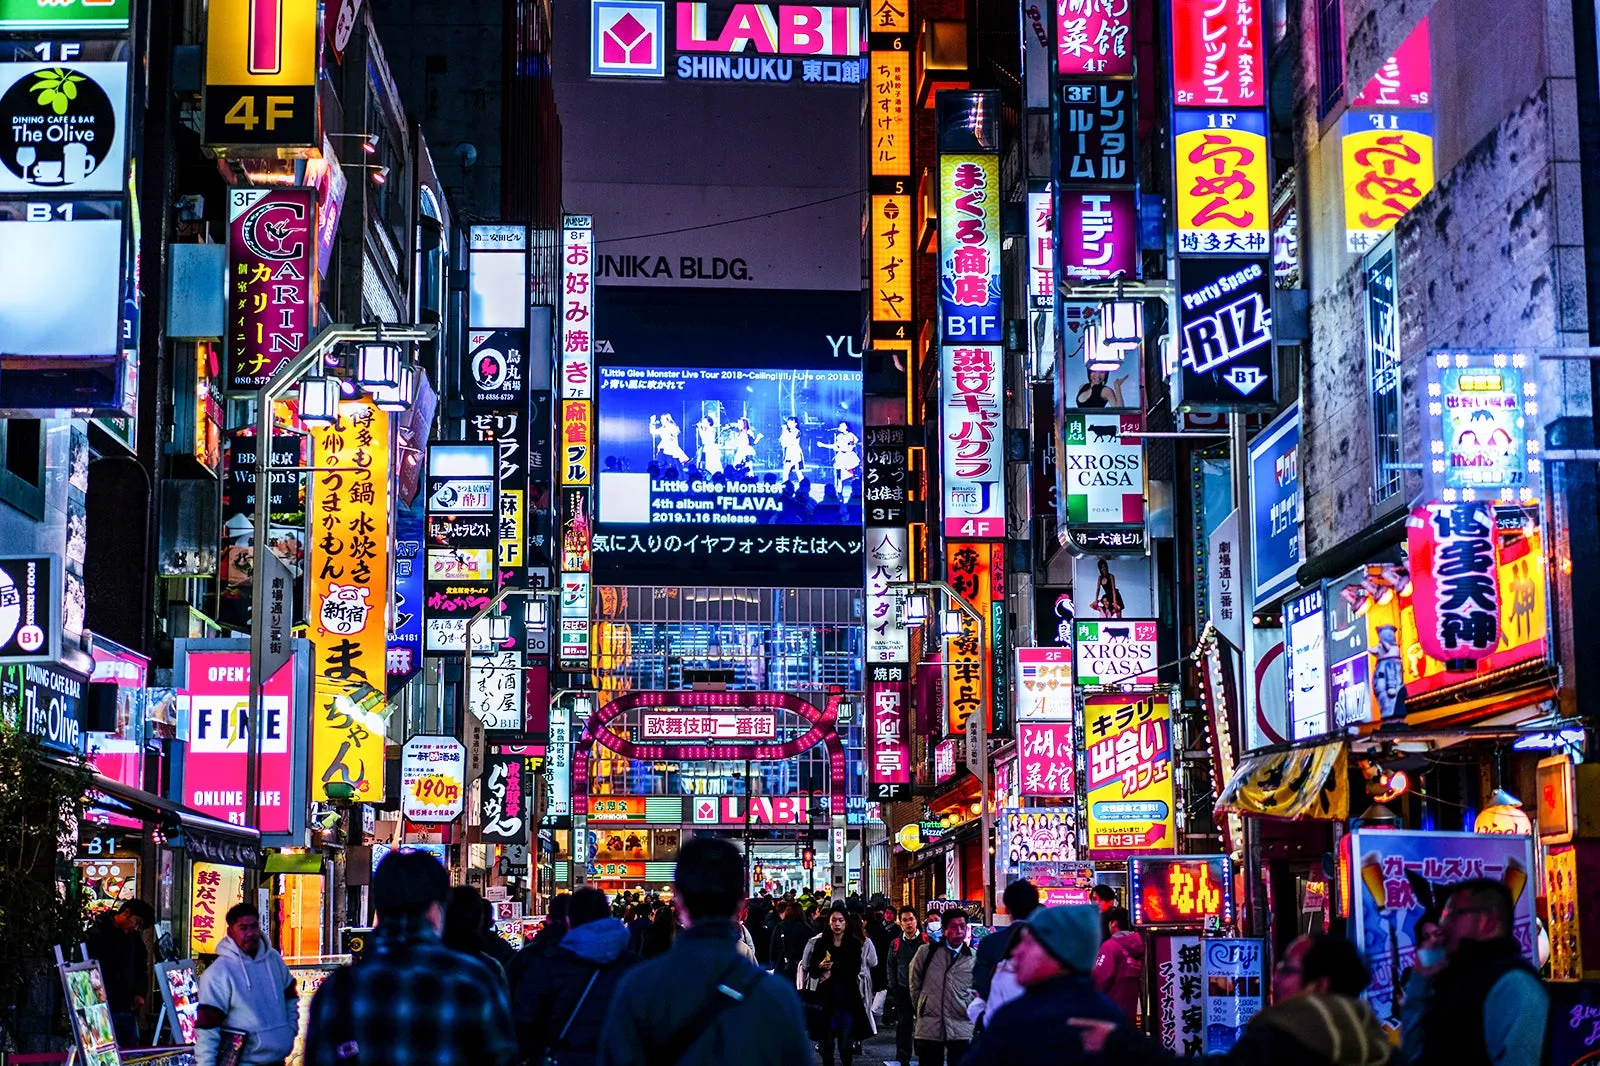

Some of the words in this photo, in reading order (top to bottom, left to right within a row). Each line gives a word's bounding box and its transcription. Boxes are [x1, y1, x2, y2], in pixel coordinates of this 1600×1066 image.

[874, 1, 905, 27] 金
[676, 2, 860, 56] LABI
[34, 42, 80, 61] 1F
[893, 37, 902, 50] 6
[677, 56, 793, 82] SHINJUKU
[802, 60, 860, 83] 東口館
[1082, 58, 1108, 72] 4F
[1238, 53, 1255, 98] ホステル
[1067, 86, 1092, 101] 3F
[1177, 90, 1194, 103] 2F
[12, 115, 44, 124] DINING
[47, 115, 68, 124] CAFE
[70, 115, 77, 124] &
[78, 115, 95, 124] BAR
[224, 95, 294, 131] 4F
[876, 65, 897, 163] ちびすけバル
[1207, 113, 1237, 129] 1F
[12, 125, 43, 143] The
[46, 124, 95, 143] Olive
[1099, 85, 1126, 179] レンタル
[1069, 109, 1096, 178] ルーム
[895, 181, 904, 195] 5
[234, 192, 257, 207] 3F
[27, 202, 73, 221] B1
[570, 231, 585, 241] 8F
[953, 162, 989, 304] まぐろ商店
[1082, 194, 1113, 266] エデン
[1181, 232, 1266, 251] 博多天神
[679, 256, 754, 282] BLDG.
[880, 222, 905, 319] すずや
[1183, 282, 1222, 311] Party
[1219, 263, 1263, 293] Space
[236, 263, 249, 374] 個室ダイニング
[249, 262, 272, 376] カリーナ
[565, 243, 590, 384] お好み焼き
[895, 326, 905, 339] 4
[947, 315, 996, 336] B1F
[1182, 292, 1272, 374] RIZ
[472, 335, 485, 344] 4F
[647, 370, 681, 379] Monster
[682, 371, 698, 379] Live
[700, 371, 720, 380] Tour
[1235, 371, 1257, 384] B1
[569, 388, 585, 398] 7F
[565, 402, 588, 443] 麻雀
[948, 348, 1000, 480] 熟女キャバクラ
[1070, 420, 1082, 432] 肉
[349, 406, 376, 508] 博多もつ鍋
[567, 446, 587, 482] ブル
[1069, 454, 1139, 470] XROSS
[234, 470, 297, 485] Waon's
[1078, 470, 1134, 487] CASA
[652, 480, 689, 494] Little
[692, 481, 724, 494] Glee
[727, 481, 787, 495] Monster
[951, 491, 977, 503] mrs
[462, 493, 487, 507] 酔月
[652, 499, 673, 511] 4th
[676, 499, 715, 511] album
[965, 481, 1000, 515] J
[653, 513, 711, 524] 2019.1.16
[713, 513, 757, 524] Release
[872, 508, 901, 521] 3F
[960, 519, 990, 537] 4F
[349, 510, 378, 584] 水炊き
[1077, 532, 1142, 546] 第一大滝ビル
[567, 557, 585, 569] 4F
[27, 562, 36, 586] FOOD
[1218, 540, 1233, 621] 劇場通り一番街
[270, 577, 283, 655] 劇場通り一番街
[22, 632, 40, 644] B1
[1079, 624, 1089, 636] 肉
[879, 651, 896, 661] 3F
[1045, 651, 1062, 661] 2F
[1082, 644, 1152, 659] XROSS
[208, 666, 243, 682] OPEN
[873, 666, 902, 682] 焼肉
[1091, 660, 1145, 675] CASA
[26, 664, 50, 687] DINING
[50, 672, 65, 693] CAFE
[497, 652, 518, 713] 居酒屋
[25, 685, 47, 736] The
[48, 694, 80, 746] Olive
[1091, 696, 1155, 737] キラリ
[647, 717, 772, 735] 歌舞伎町一番街
[875, 688, 902, 776] 安楽亭
[1091, 720, 1165, 786] 出会い
[1121, 757, 1169, 796] カフェ
[193, 790, 243, 806] ONLINE
[415, 779, 459, 800] 190円
[878, 784, 900, 798] 2F
[594, 801, 628, 812] 吉野家
[721, 796, 812, 824] LABI
[541, 815, 558, 825] 2F
[87, 836, 117, 854] B1
[1383, 856, 1504, 878] ガールズバー
[1169, 863, 1220, 914] なん
[193, 870, 221, 943] 鉄なべ餃子
[505, 924, 520, 934] 3F
